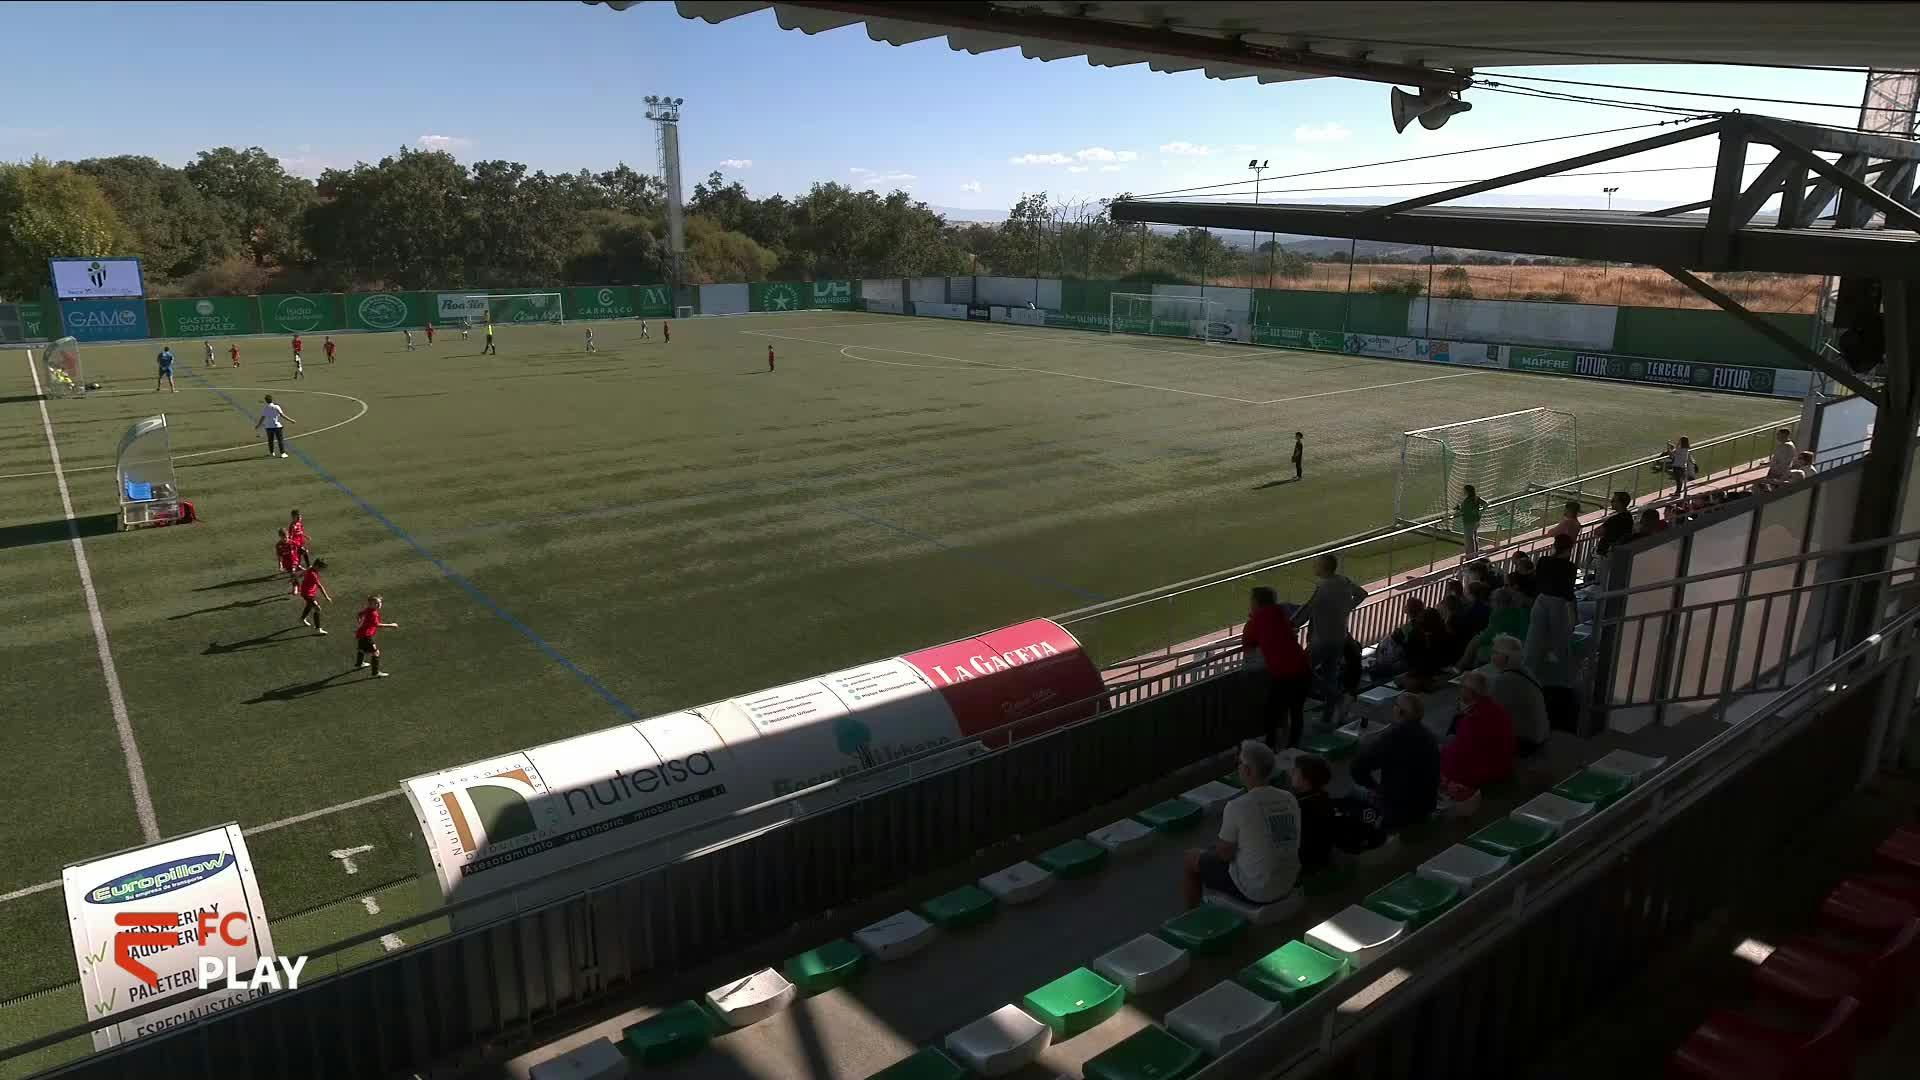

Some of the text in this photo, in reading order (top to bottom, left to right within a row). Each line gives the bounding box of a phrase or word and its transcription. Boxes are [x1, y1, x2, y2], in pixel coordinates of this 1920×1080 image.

[579, 305, 633, 315] CARRASCO
[178, 316, 218, 325] CASTRO
[1521, 356, 1569, 369] MAPFRE
[1647, 361, 1691, 378] TERCERA
[969, 641, 1060, 677] GACETA
[93, 851, 226, 901] Europillow
[129, 967, 198, 1002] PALETERI
